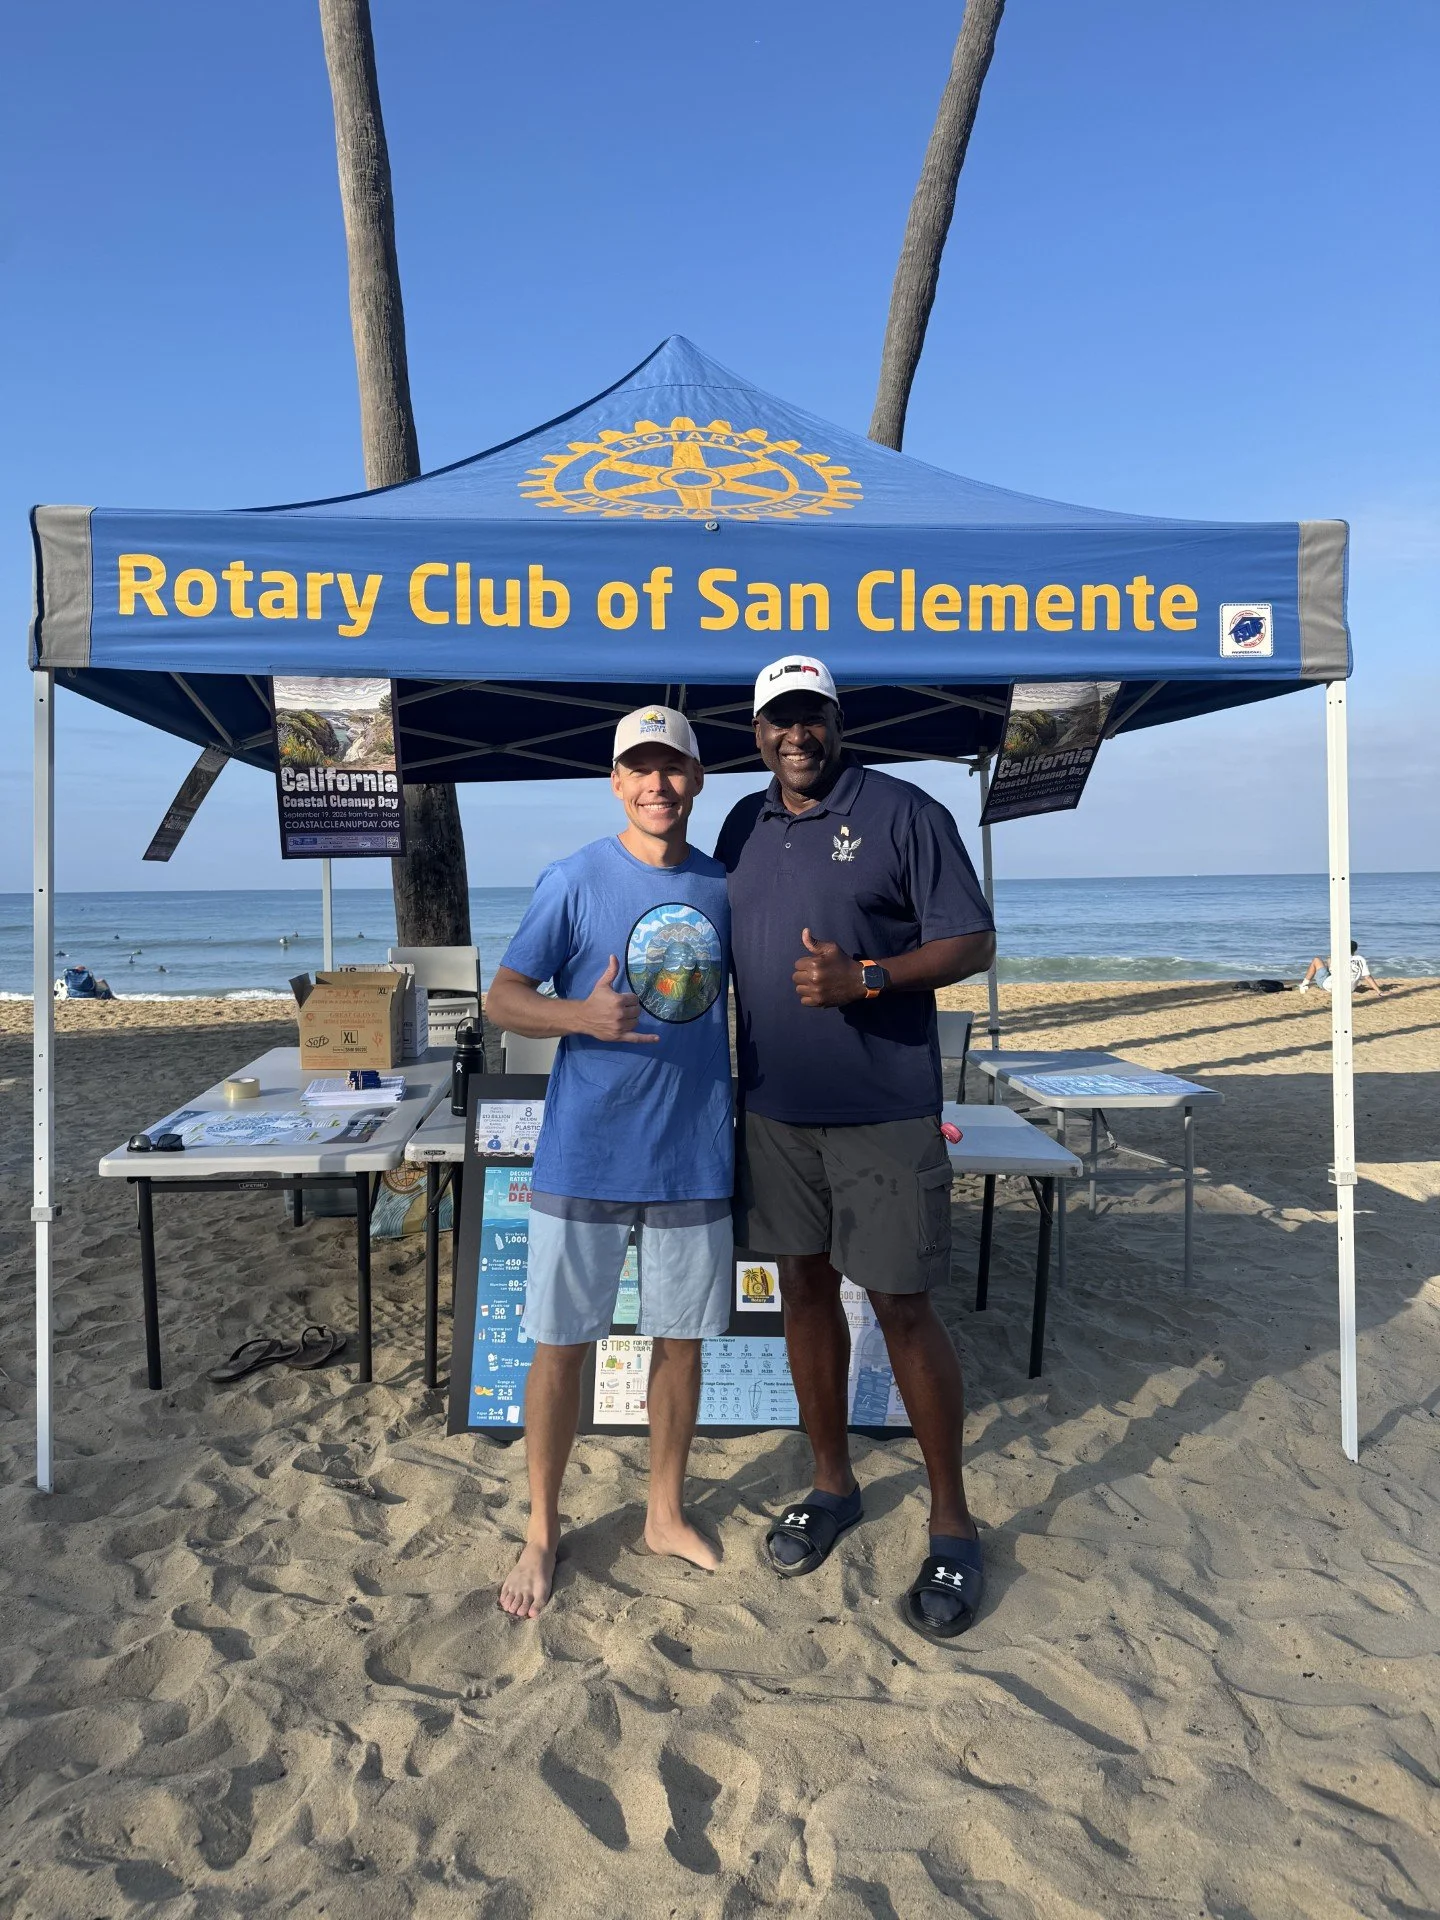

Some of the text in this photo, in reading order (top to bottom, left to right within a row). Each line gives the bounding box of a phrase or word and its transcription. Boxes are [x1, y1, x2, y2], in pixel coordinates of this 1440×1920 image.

[620, 430, 752, 450] ROTARY
[576, 496, 819, 517] INTERNATIONAL
[118, 553, 1198, 638] Rotary Club of San Clemente
[770, 664, 819, 681] USA
[998, 748, 1094, 780] California
[280, 767, 398, 792] California
[994, 778, 1029, 791] Coastal
[1030, 770, 1068, 784] Cleanup
[1068, 766, 1088, 777] Day
[282, 795, 398, 810] Coastal Cleanup Day
[284, 820, 400, 829] COASTALCLEANUPDAY.ORG
[309, 1035, 328, 1046] Soft
[344, 1032, 356, 1043] XL
[525, 1107, 532, 1117] 8
[602, 1340, 607, 1351] 9
[610, 1340, 630, 1351] TIPS
